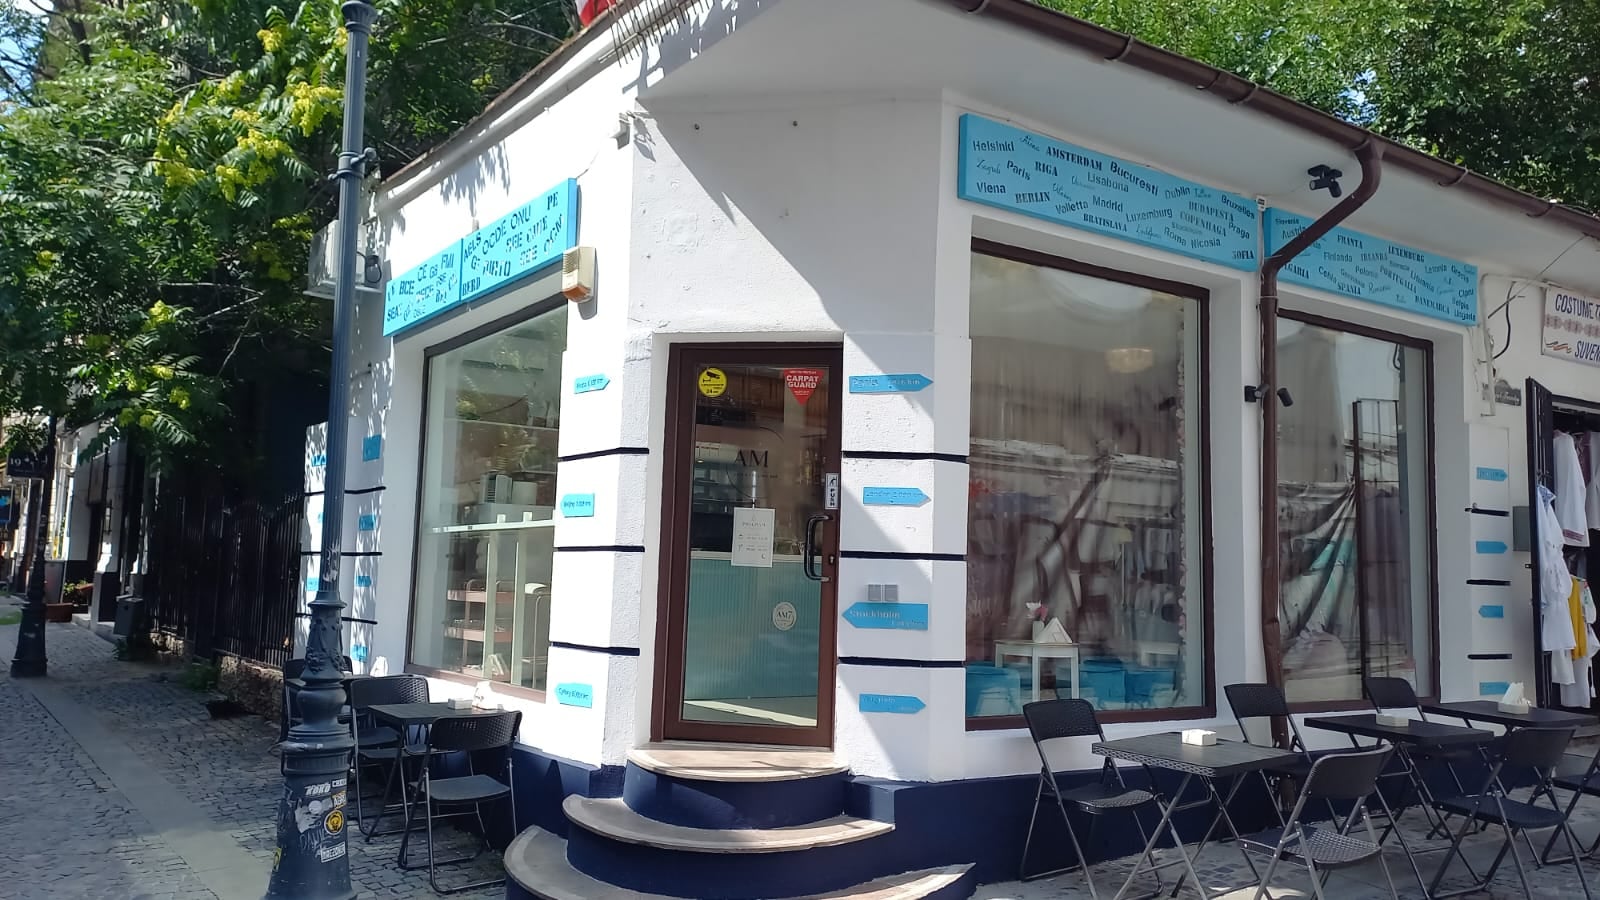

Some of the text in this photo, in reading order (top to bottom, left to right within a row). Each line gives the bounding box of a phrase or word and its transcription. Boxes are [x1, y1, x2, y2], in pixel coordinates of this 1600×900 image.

[973, 140, 1015, 152] Helsinki
[1046, 146, 1102, 171] AMSTERDAM
[1006, 160, 1031, 181] Paris
[1035, 161, 1058, 177] RIGA
[1110, 160, 1159, 197] Bucuresti
[976, 181, 1006, 194] Viena
[1165, 185, 1191, 200] Dublin
[1015, 191, 1051, 204] BERLIN
[1092, 194, 1123, 213] Madrid
[510, 205, 533, 230] ONU
[1083, 213, 1127, 232] BRATISLAVA
[1126, 207, 1173, 223] Luxemburg
[482, 219, 508, 256] OCDE
[1164, 226, 1187, 247] Roma
[1228, 221, 1251, 240] Praga
[463, 231, 482, 263] AELS
[1191, 238, 1222, 249] Nicosia
[1555, 294, 1594, 320] COSTUME
